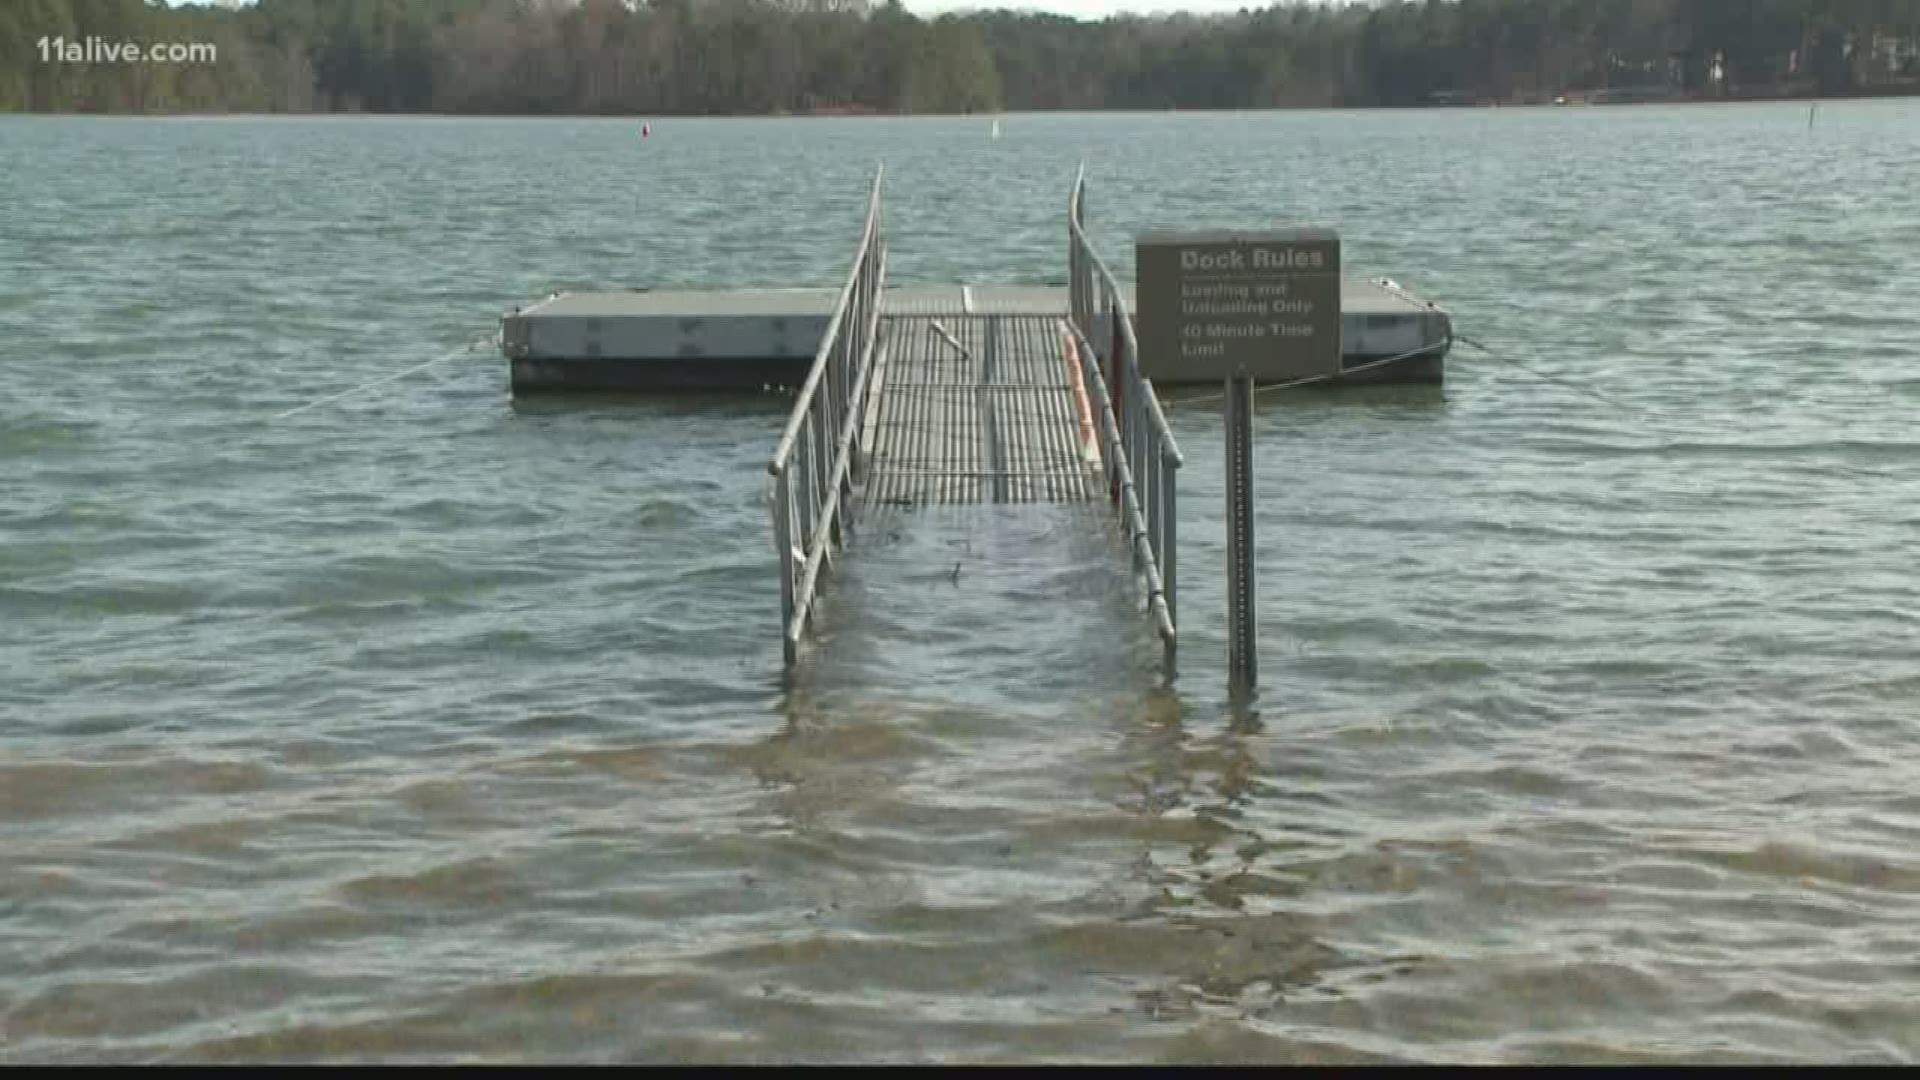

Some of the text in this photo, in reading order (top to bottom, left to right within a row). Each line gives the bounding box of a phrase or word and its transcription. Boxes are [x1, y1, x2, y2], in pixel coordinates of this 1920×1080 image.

[1181, 249, 1323, 269] Dock Rules
[1256, 284, 1288, 296] and
[1272, 299, 1313, 315] Only
[1207, 323, 1265, 337] Minute
[1271, 322, 1313, 337] Time
[1181, 342, 1224, 356] Limit
